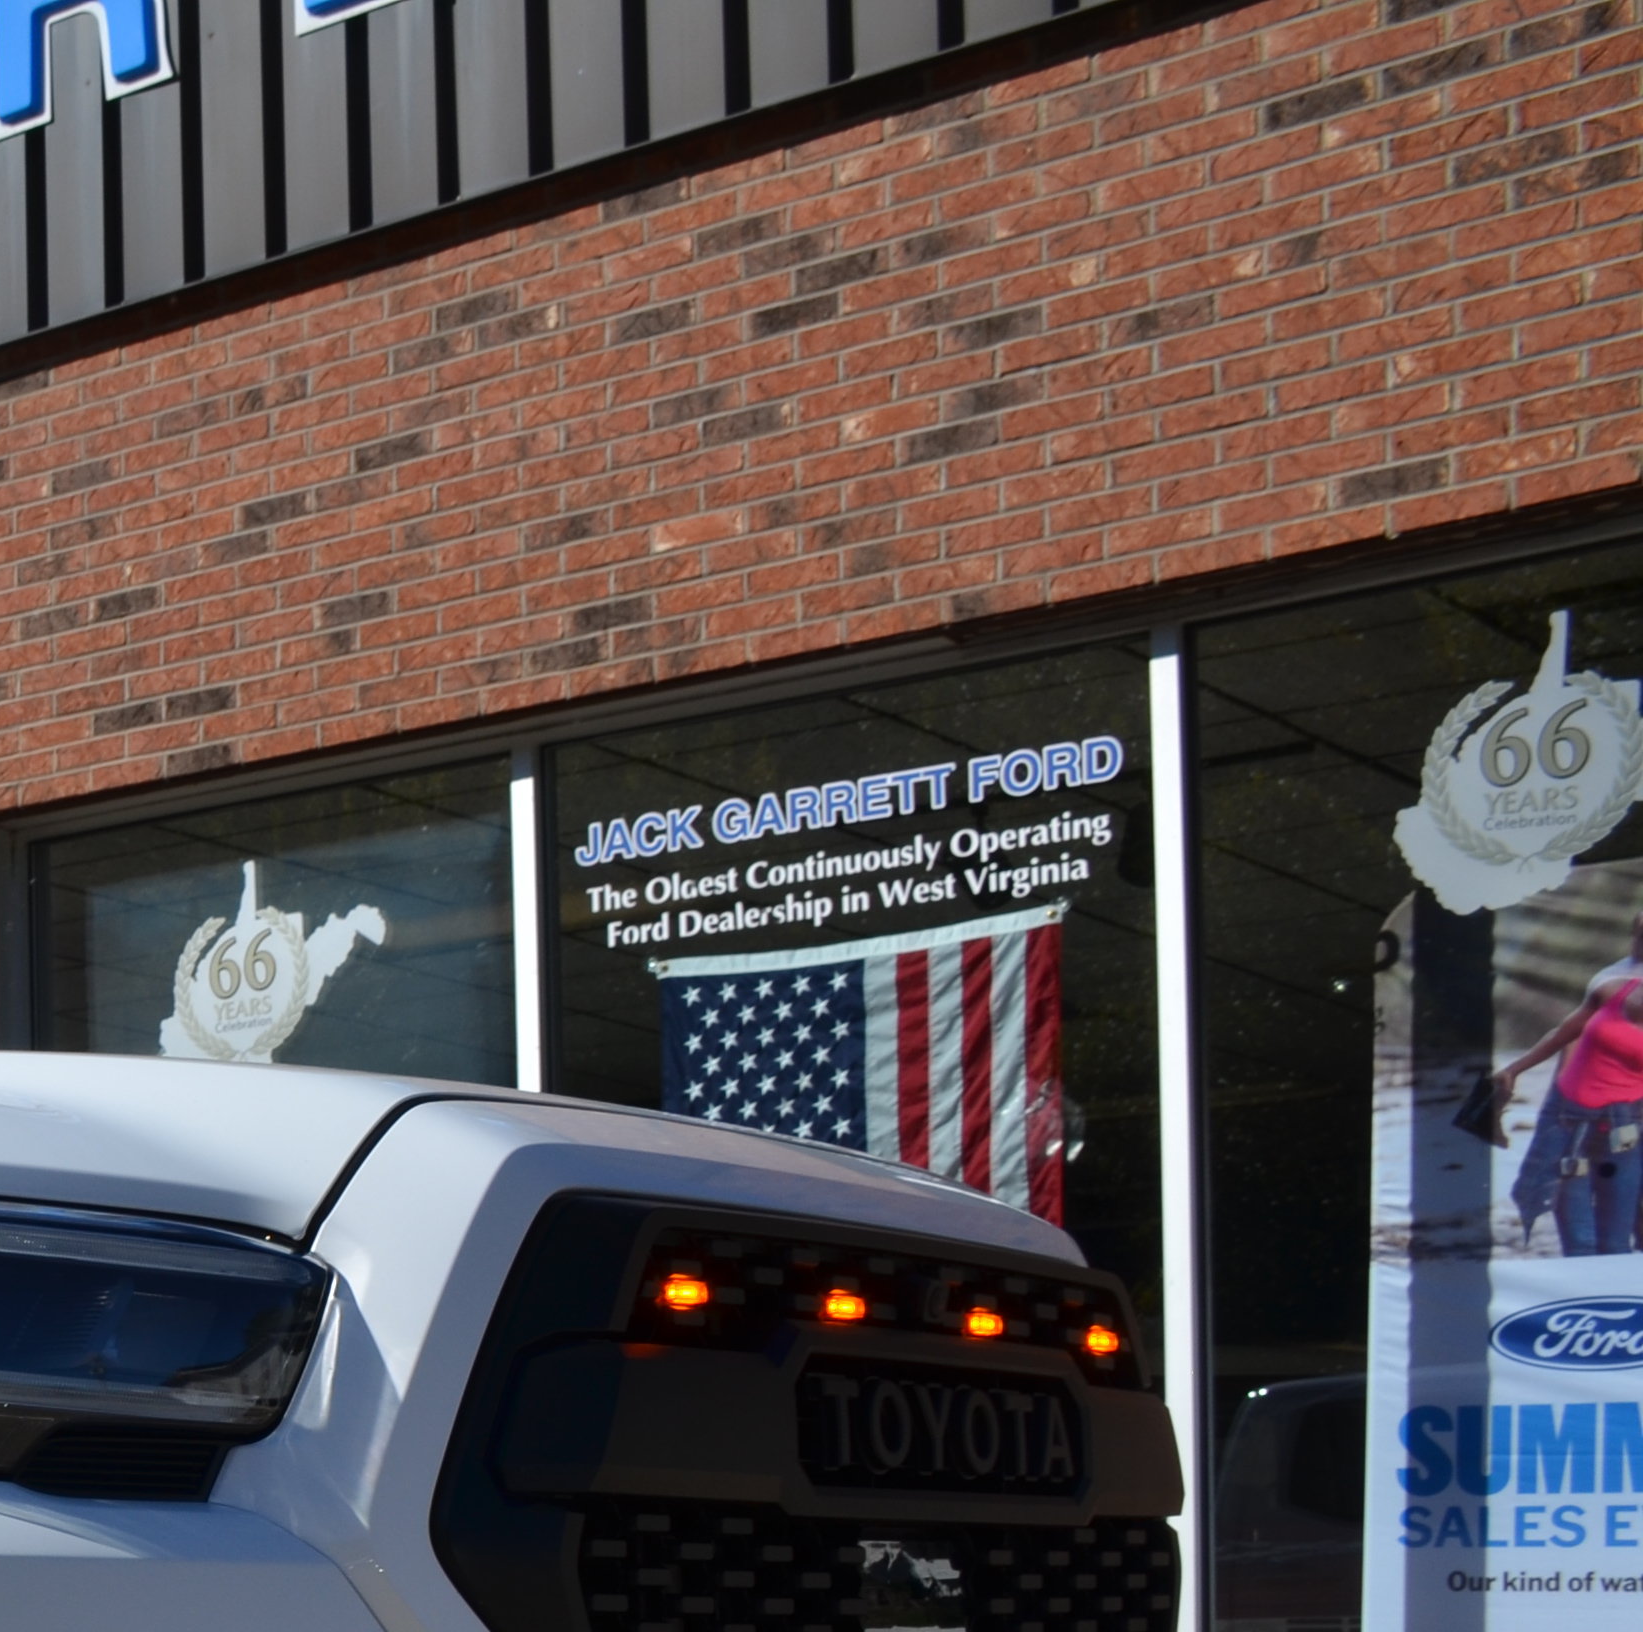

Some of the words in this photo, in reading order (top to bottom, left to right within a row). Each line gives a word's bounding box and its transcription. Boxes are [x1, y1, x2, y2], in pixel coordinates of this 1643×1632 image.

[1479, 697, 1591, 788] 66
[574, 805, 703, 866] JACK
[713, 762, 956, 844] GARRETT
[967, 735, 1124, 803] FORD
[1483, 785, 1579, 815] YEARS
[1483, 813, 1577, 831] Celebration
[587, 884, 637, 914] The
[746, 834, 942, 895] Continuously
[949, 810, 1113, 860] Operating
[607, 915, 670, 948] Ford
[679, 895, 833, 938] Dealership
[841, 886, 870, 914] in
[878, 874, 956, 908] West
[963, 853, 1090, 898] Virginia
[208, 927, 277, 1000] 66
[213, 996, 273, 1022] YEARS
[214, 1016, 273, 1034] Celebration
[818, 1359, 1075, 1482] TOYOTA
[1397, 1505, 1587, 1549] SALES
[1605, 1505, 1643, 1547] E
[1447, 1570, 1497, 1592] Our
[1503, 1570, 1562, 1592] kind
[1568, 1570, 1595, 1592] of
